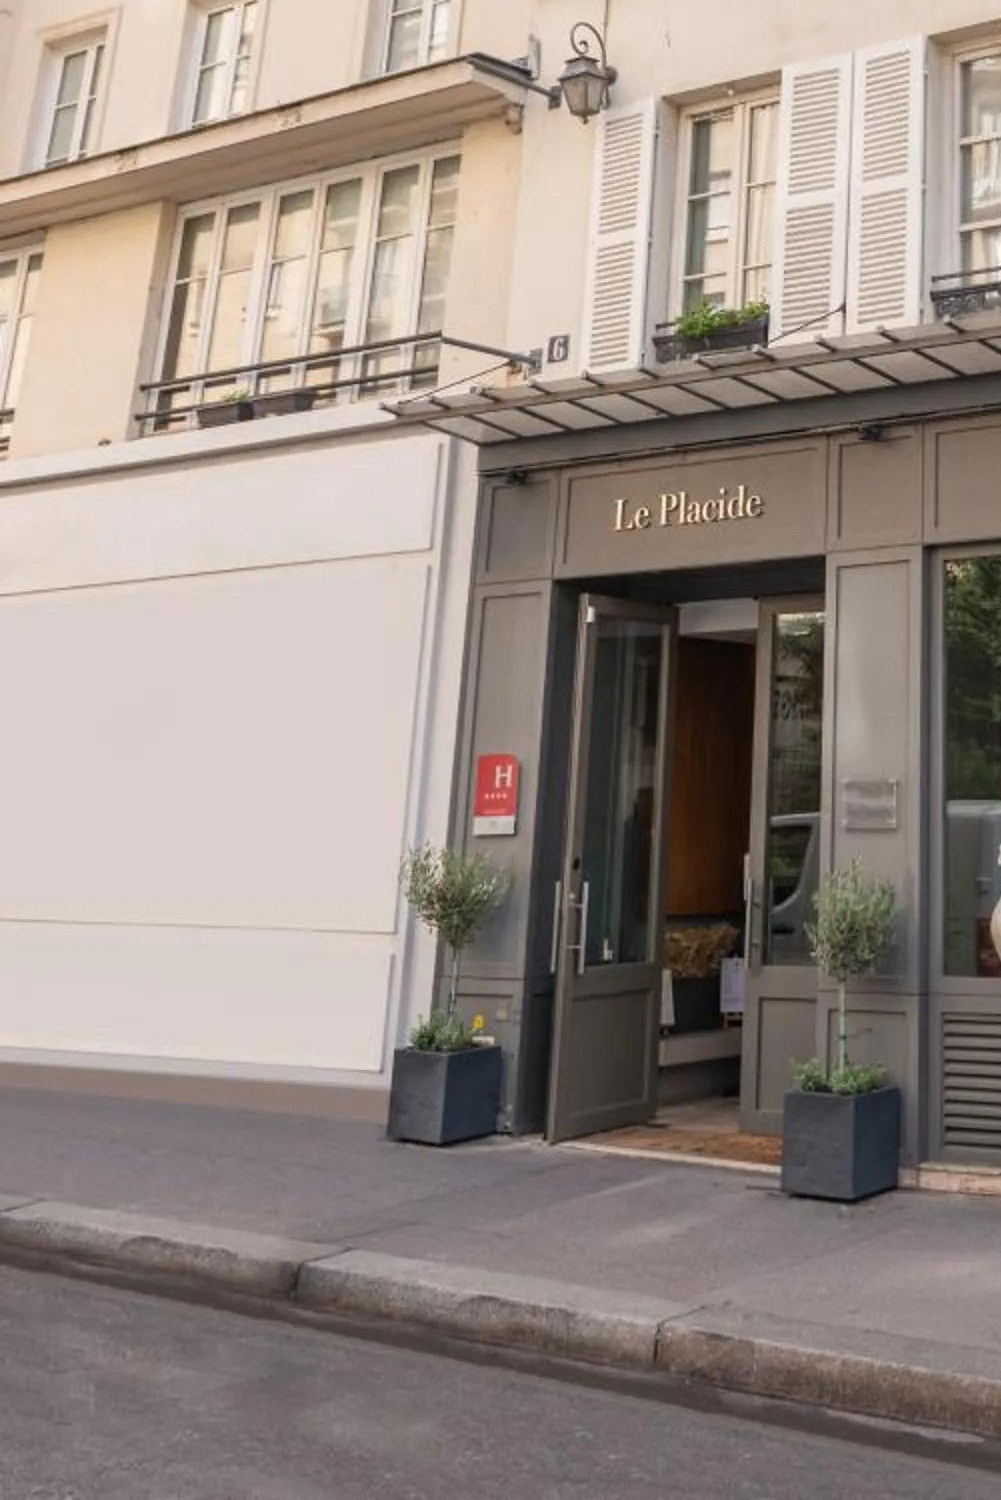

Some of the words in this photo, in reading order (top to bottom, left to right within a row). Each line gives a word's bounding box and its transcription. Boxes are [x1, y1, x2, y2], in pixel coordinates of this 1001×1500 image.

[553, 338, 566, 360] 6
[614, 499, 651, 531] Le
[659, 484, 763, 527] Placide
[495, 764, 513, 789] H
